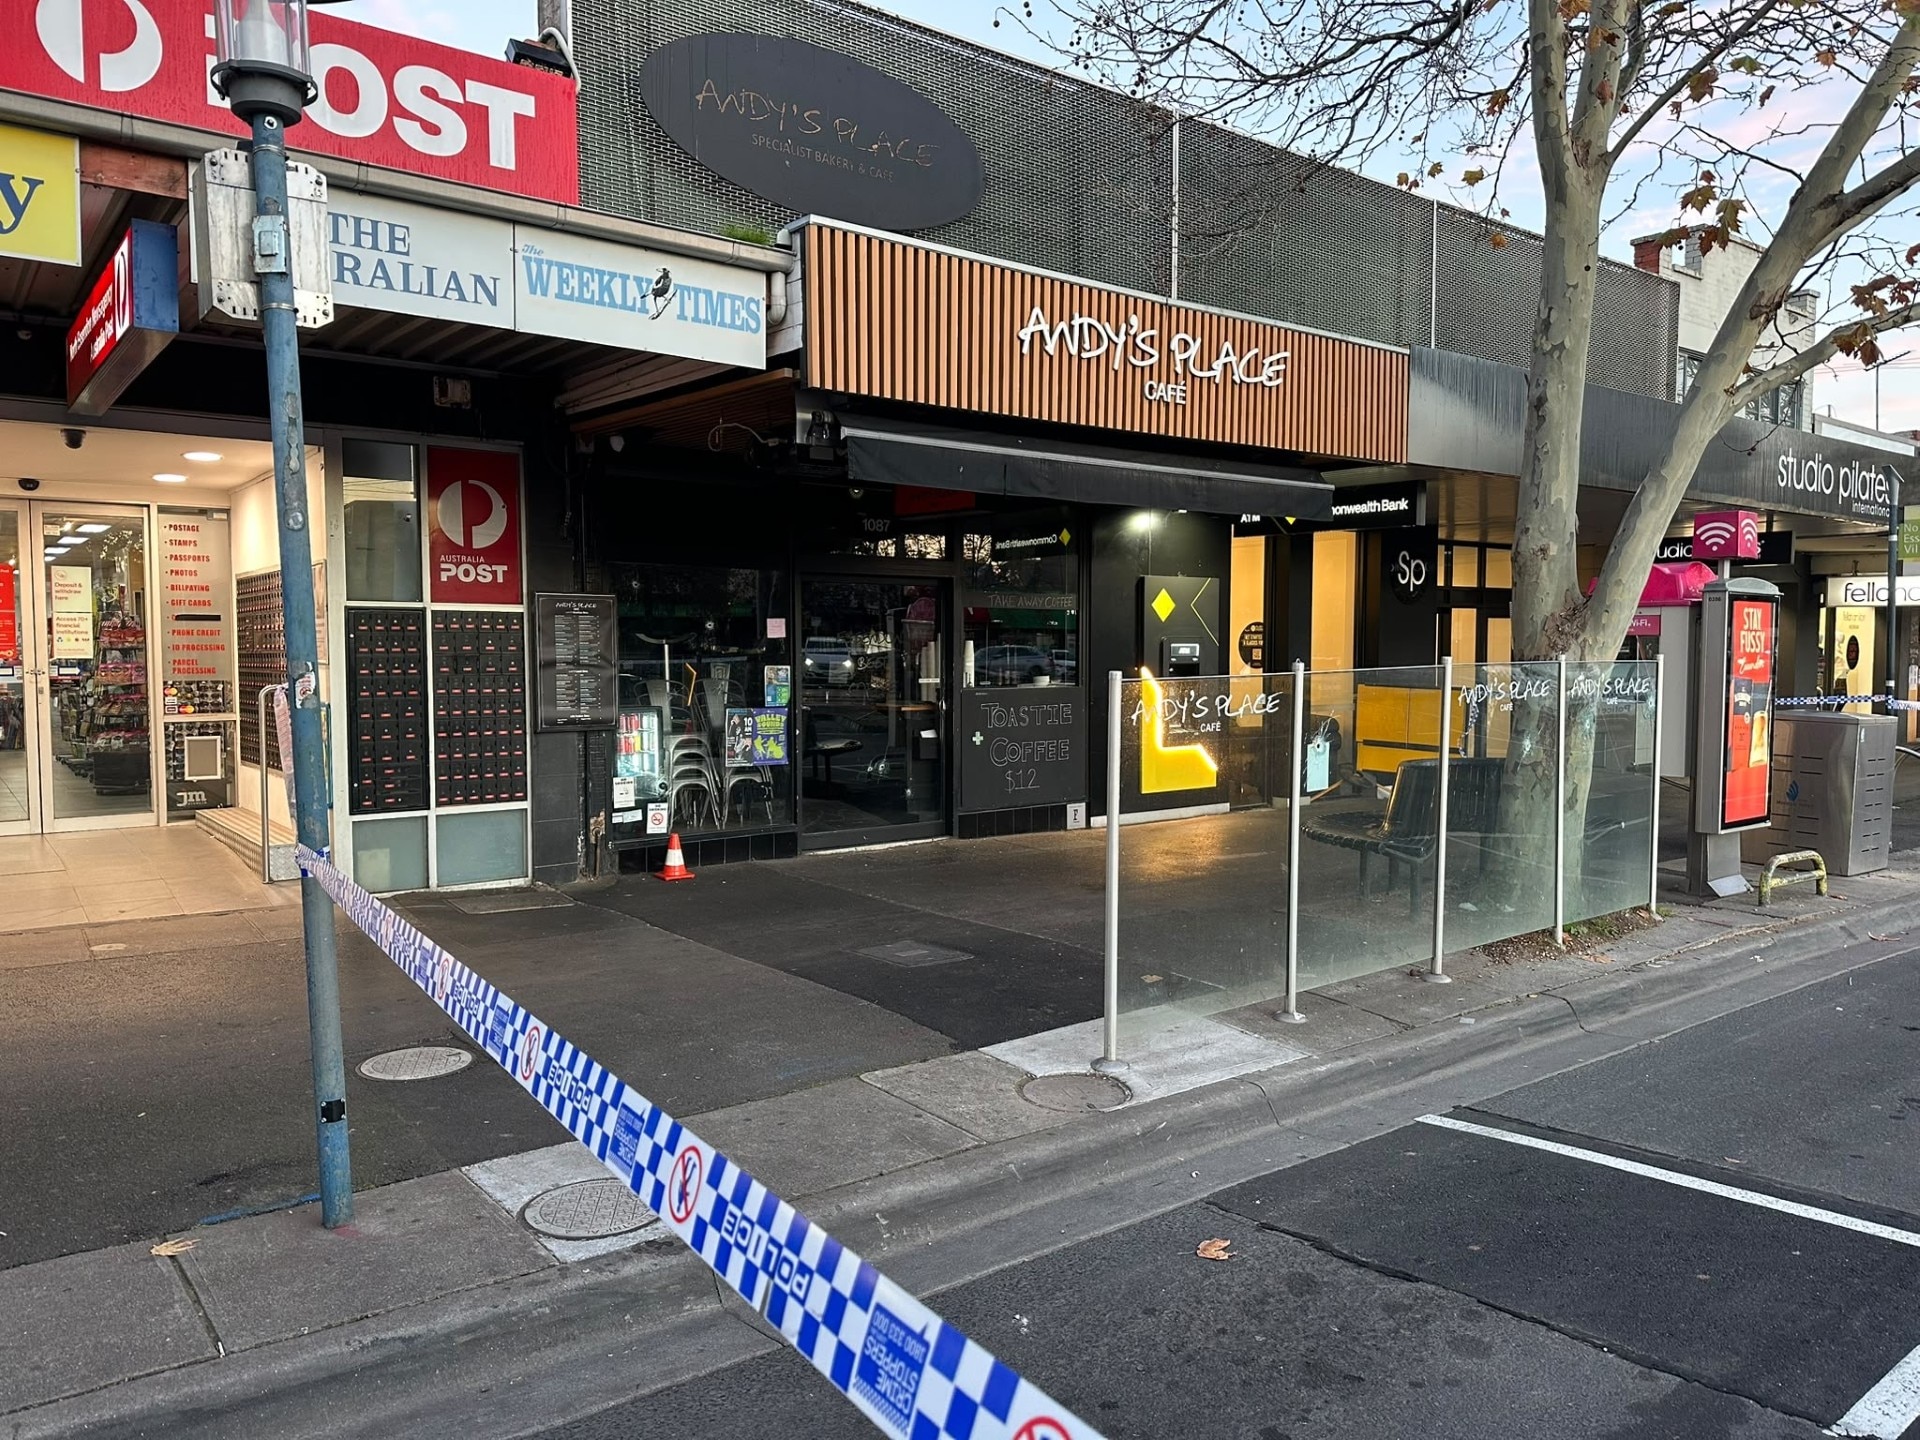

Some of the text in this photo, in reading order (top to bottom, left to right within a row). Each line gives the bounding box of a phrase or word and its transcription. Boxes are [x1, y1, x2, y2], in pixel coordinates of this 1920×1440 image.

[695, 78, 940, 168] ANDY'S PLACE
[751, 133, 813, 161] SPECIALIST
[327, 211, 411, 257] THE
[521, 243, 545, 258] The
[521, 254, 762, 335] WEEKLY TIMES
[1018, 306, 1290, 387] ANDY'S PLACE
[1144, 379, 1187, 405] CAFÉ
[1777, 447, 1835, 496] studio
[1382, 498, 1409, 514] Bank
[168, 524, 200, 532] POSTAGE
[862, 518, 890, 533] 1087
[168, 539, 198, 548] STAMPS
[169, 554, 211, 562] PASSPORTS
[440, 555, 485, 563] AUSTRALIA
[1397, 550, 1426, 592] Sp
[170, 569, 198, 577] PHOTOS
[440, 563, 508, 583] POST
[170, 599, 212, 607] GIFT CARDS
[1017, 594, 1044, 608] AWAY
[1045, 595, 1074, 608] COFFEE
[1743, 607, 1763, 630] STAY
[171, 629, 221, 637] PHONE CREDIT
[1740, 630, 1766, 654] FUSSY
[182, 644, 225, 652] PROCESSING
[172, 667, 217, 675] PROCESSING
[1458, 677, 1551, 706] ANDY'S PLACE
[1567, 672, 1651, 699] ANDY'S PLACE
[981, 702, 1073, 728] TOASTIE
[1131, 689, 1283, 726] ANDY'S PLACE
[1200, 721, 1221, 732] CAFÉ
[989, 737, 1070, 767] COFFEE
[1005, 768, 1040, 794] $12
[548, 1060, 593, 1115] POLICE
[721, 1207, 814, 1299] POLICE
[863, 1335, 919, 1393] STOPPERS
[874, 1368, 912, 1415] CRIME
